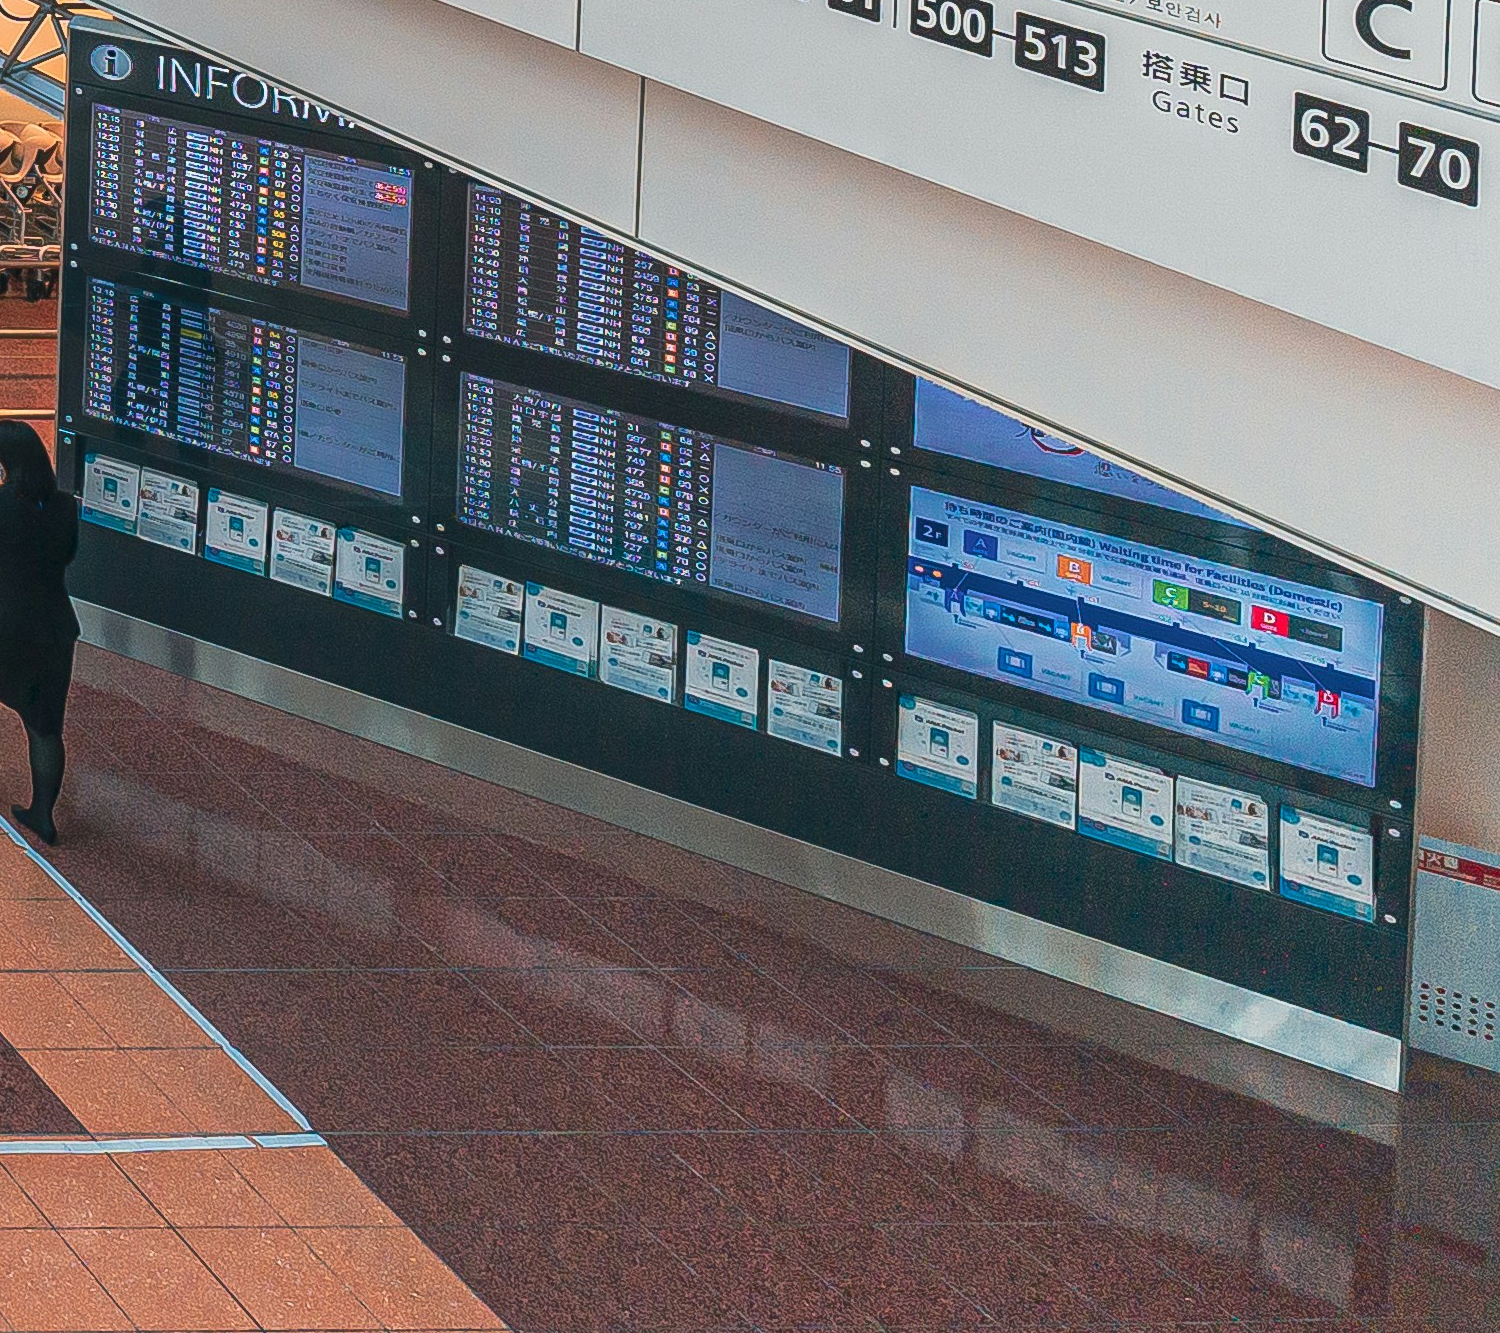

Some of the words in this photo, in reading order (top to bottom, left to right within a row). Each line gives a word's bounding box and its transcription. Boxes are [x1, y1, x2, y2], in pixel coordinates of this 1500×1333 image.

[1023, 24, 1098, 77] 513
[1142, 49, 1250, 106] 搭乗口
[1301, 108, 1361, 161] 62
[1407, 136, 1471, 190] 70
[1152, 90, 1240, 134] Gates
[975, 538, 988, 548] A
[1165, 587, 1177, 599] C
[1263, 612, 1276, 624] D
